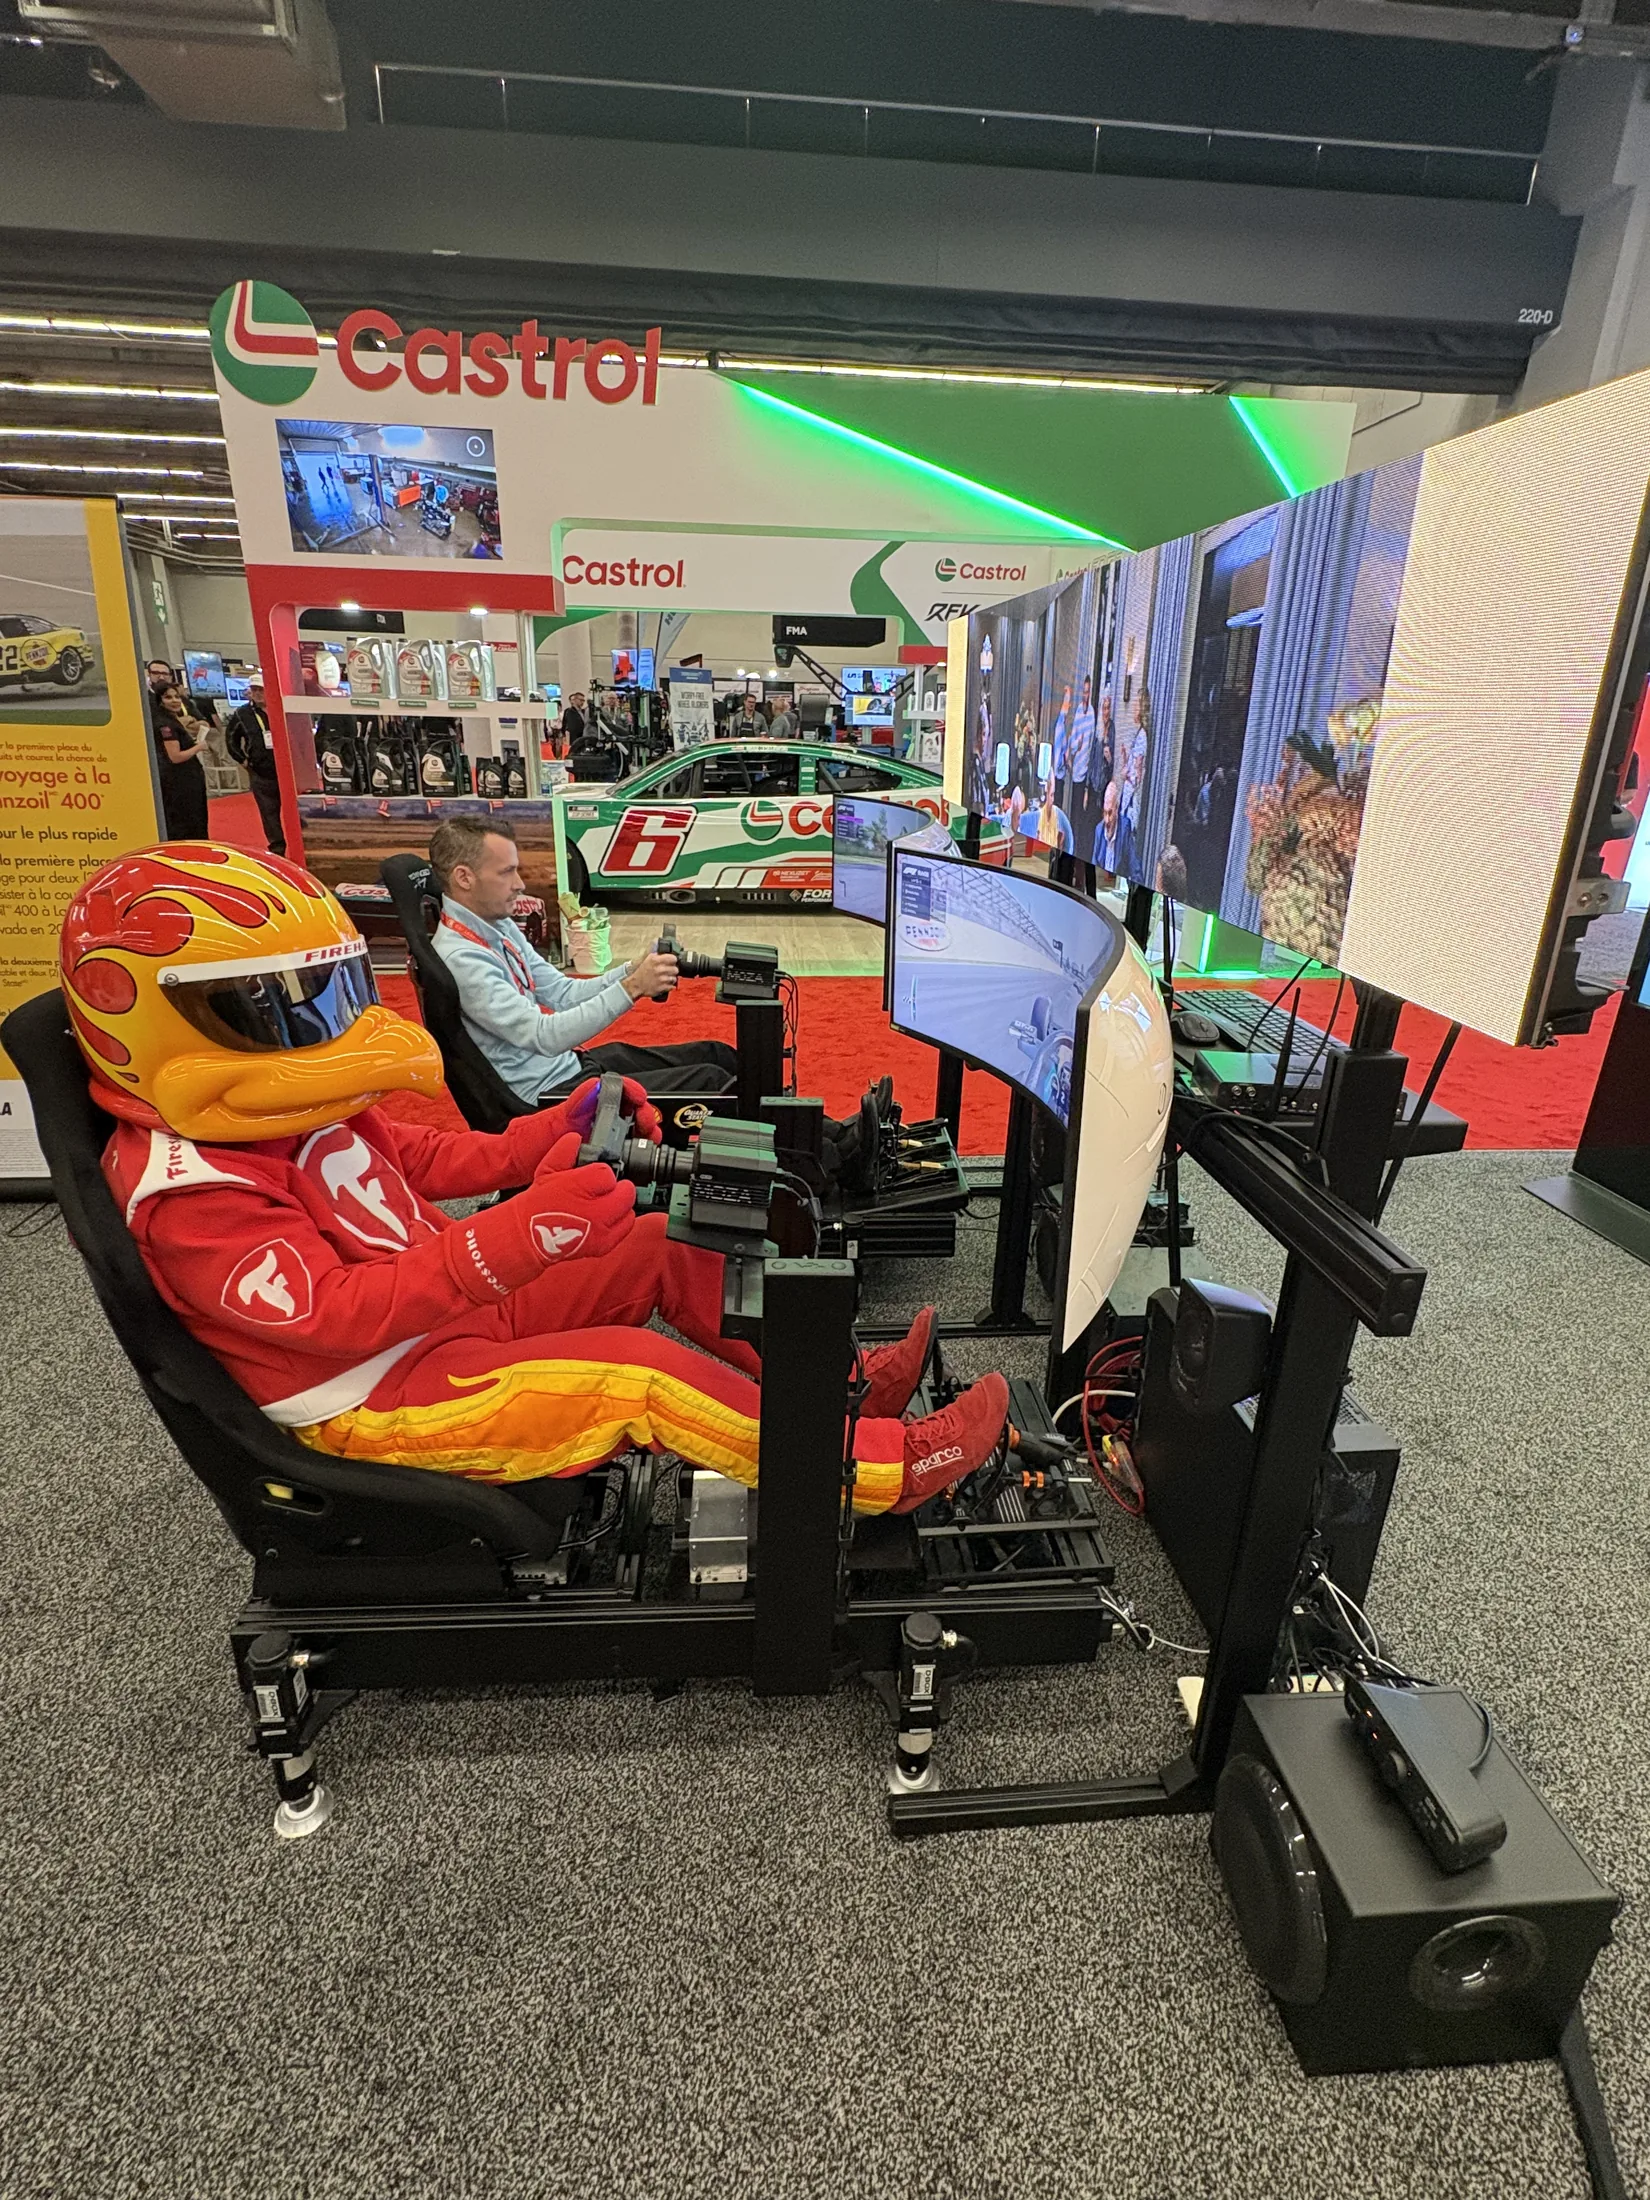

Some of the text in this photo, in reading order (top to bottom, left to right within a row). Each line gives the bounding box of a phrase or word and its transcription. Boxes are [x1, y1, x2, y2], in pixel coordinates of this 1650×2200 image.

[1518, 308, 1553, 324] 220-D
[337, 308, 661, 406] Castrol
[563, 555, 684, 588] Castrol
[960, 564, 1027, 581] Castrol
[786, 626, 807, 636] FMA
[5, 741, 14, 750] la
[57, 742, 79, 752] place
[81, 743, 92, 752] du
[56, 753, 65, 761] la
[66, 754, 94, 762] chance
[96, 753, 107, 762] de
[74, 766, 87, 784] à
[92, 765, 111, 784] la
[21, 825, 34, 839] le
[38, 825, 68, 843] plus
[72, 826, 118, 844] rapide
[600, 806, 697, 876] 6
[14, 854, 75, 869] première
[19, 874, 45, 886] pour
[48, 871, 80, 883] deux
[28, 888, 37, 900] à
[39, 887, 51, 900] la
[14, 904, 39, 917] 400
[41, 904, 50, 917] à
[30, 927, 45, 935] en
[727, 970, 764, 983] MOZA
[911, 1446, 963, 1474] sparco
[268, 1691, 280, 1717] D-BOX
